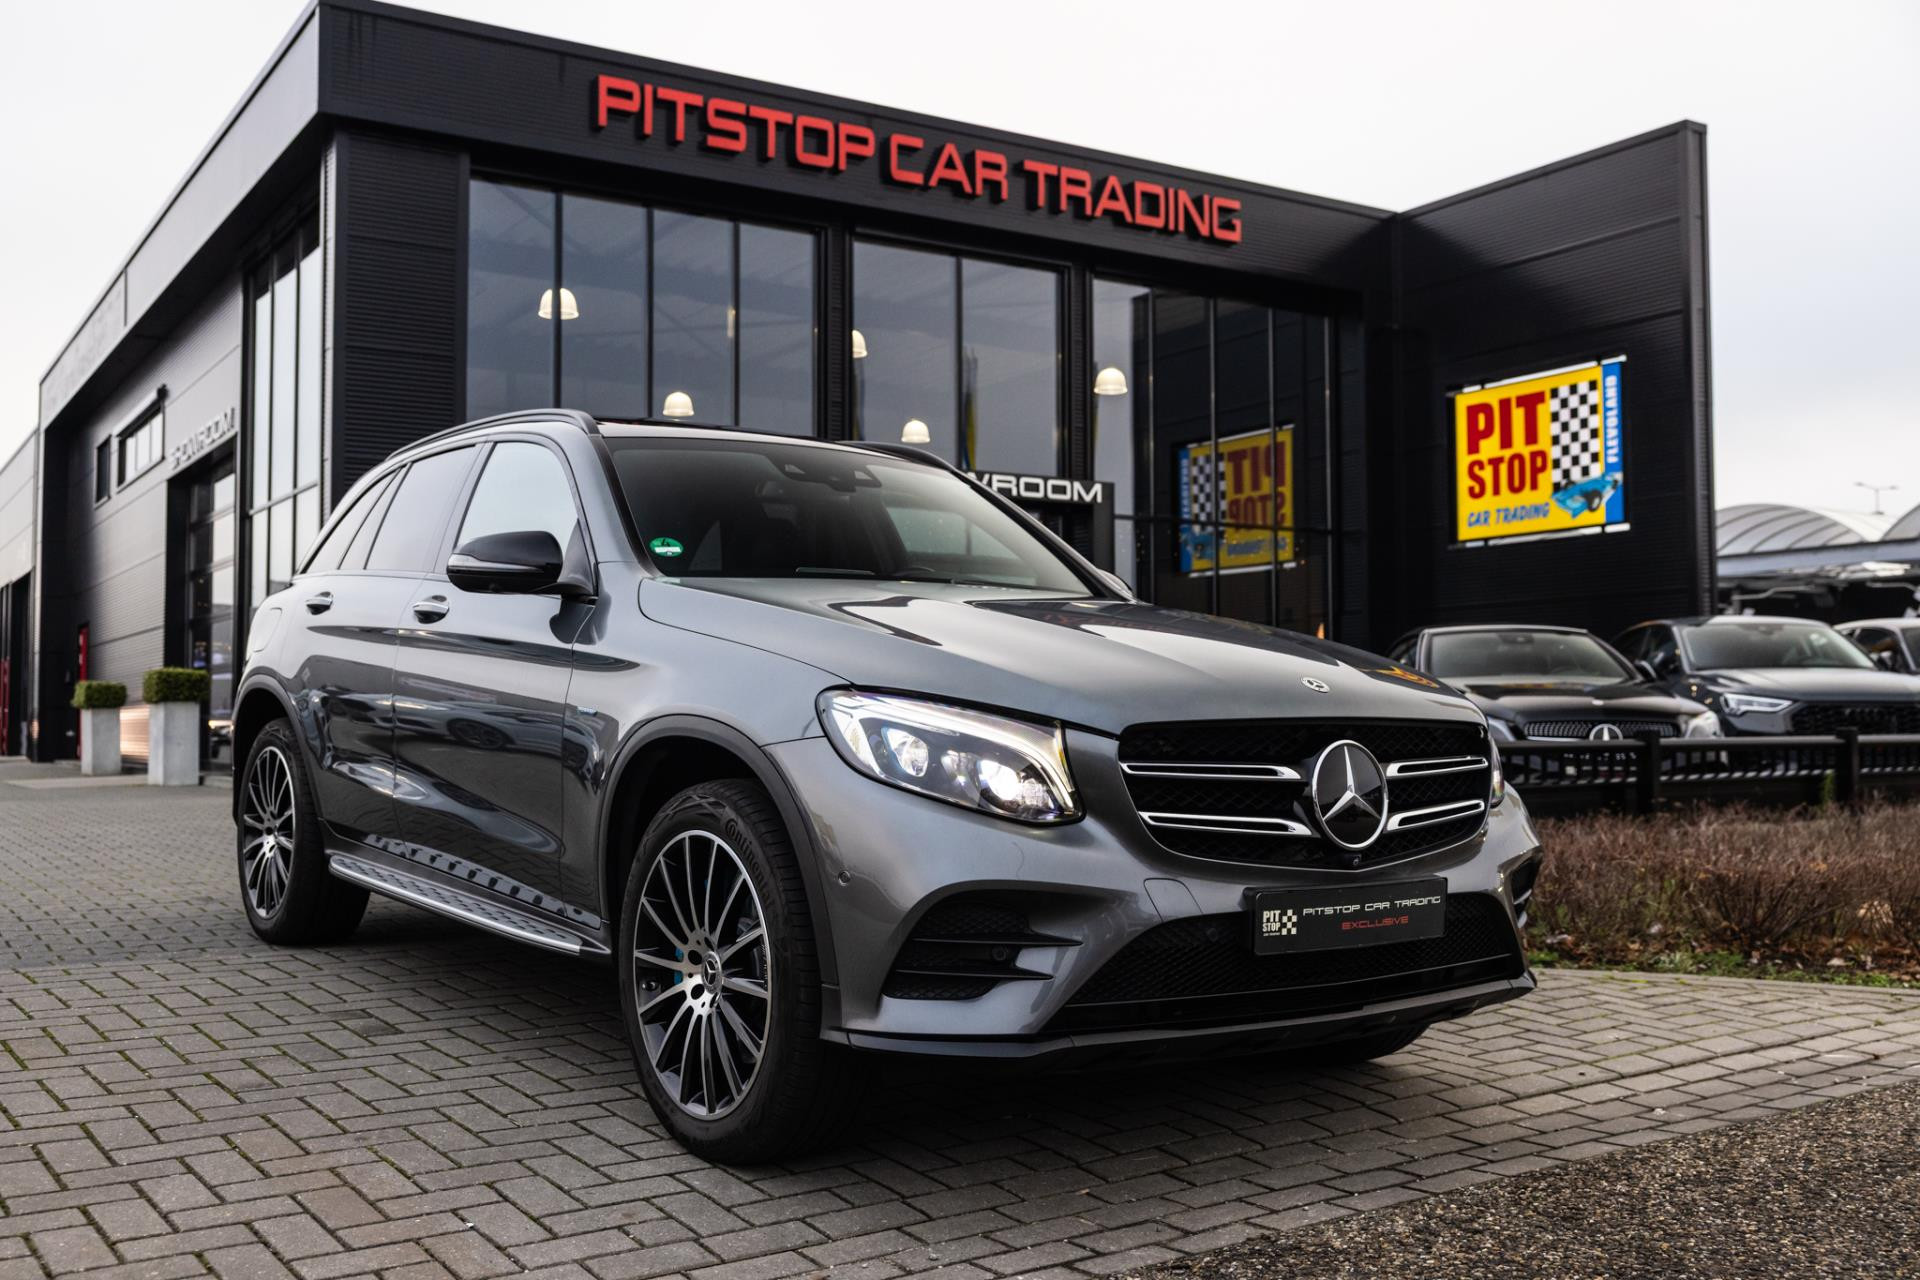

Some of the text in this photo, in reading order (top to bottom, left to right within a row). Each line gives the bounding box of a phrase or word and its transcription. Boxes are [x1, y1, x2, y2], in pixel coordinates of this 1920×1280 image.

[597, 73, 1243, 243] PITSTOP CAR TRADING
[1466, 390, 1546, 455] PIT
[1466, 450, 1548, 500] STOP
[1467, 502, 1550, 528] CAR TRADING
[1263, 910, 1281, 922] PIT
[1303, 896, 1441, 916] PITSTOP CAR TRADING
[1262, 922, 1281, 932] STOP
[1341, 915, 1409, 930] EXCLUSIVE
